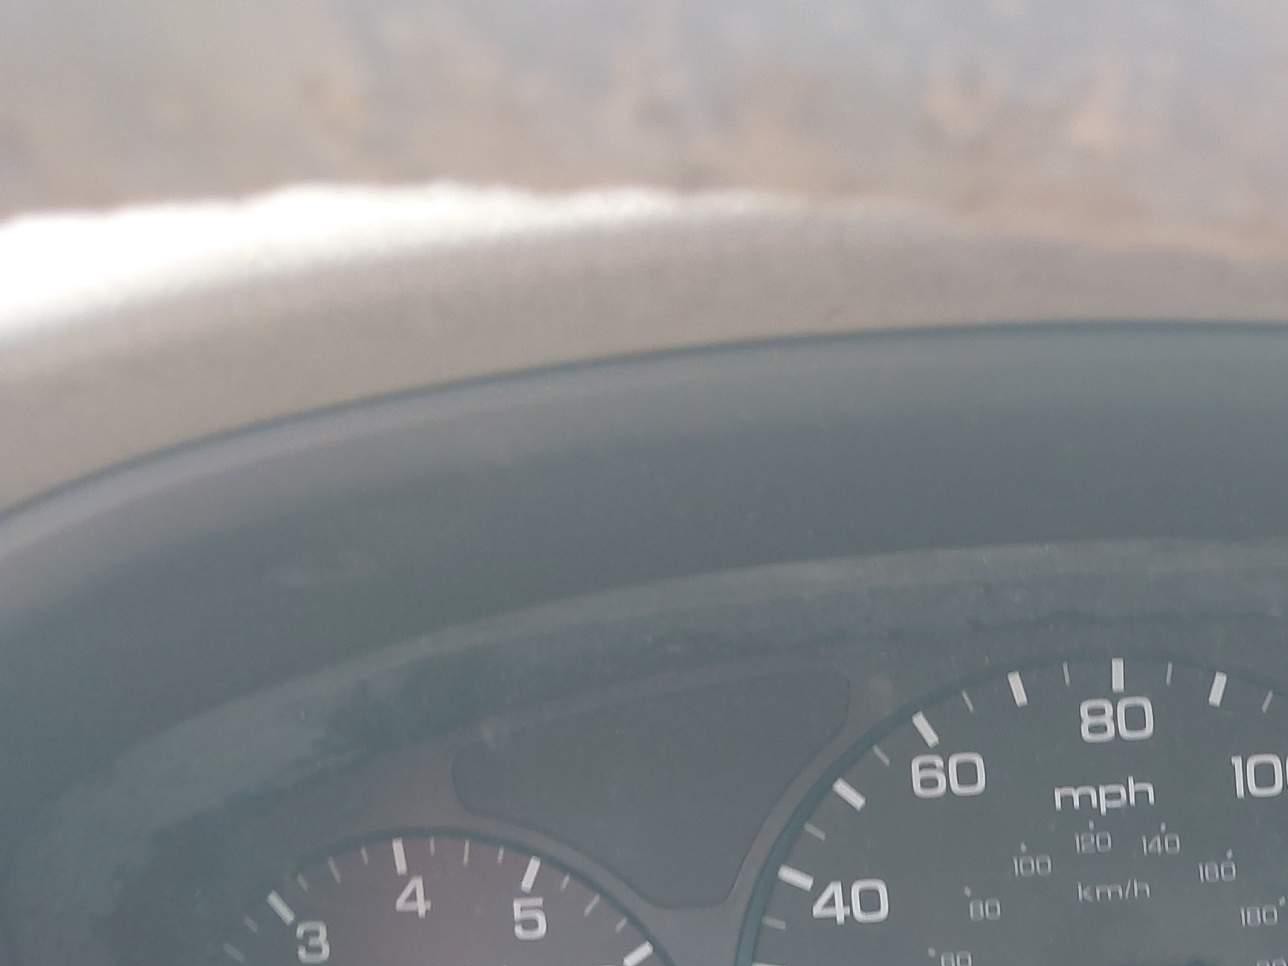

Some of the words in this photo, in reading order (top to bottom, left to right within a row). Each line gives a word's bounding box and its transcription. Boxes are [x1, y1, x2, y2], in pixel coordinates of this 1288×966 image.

[1080, 697, 1153, 742] 80
[912, 753, 985, 797] 60
[1055, 776, 1154, 814] mph
[1076, 832, 1111, 853] 120
[1143, 831, 1180, 855] 140
[1014, 856, 1051, 876] 100
[396, 877, 431, 917] 4
[811, 879, 890, 925] 40
[1078, 879, 1149, 901] km/h
[513, 898, 546, 939] 5
[297, 921, 330, 963] 3
